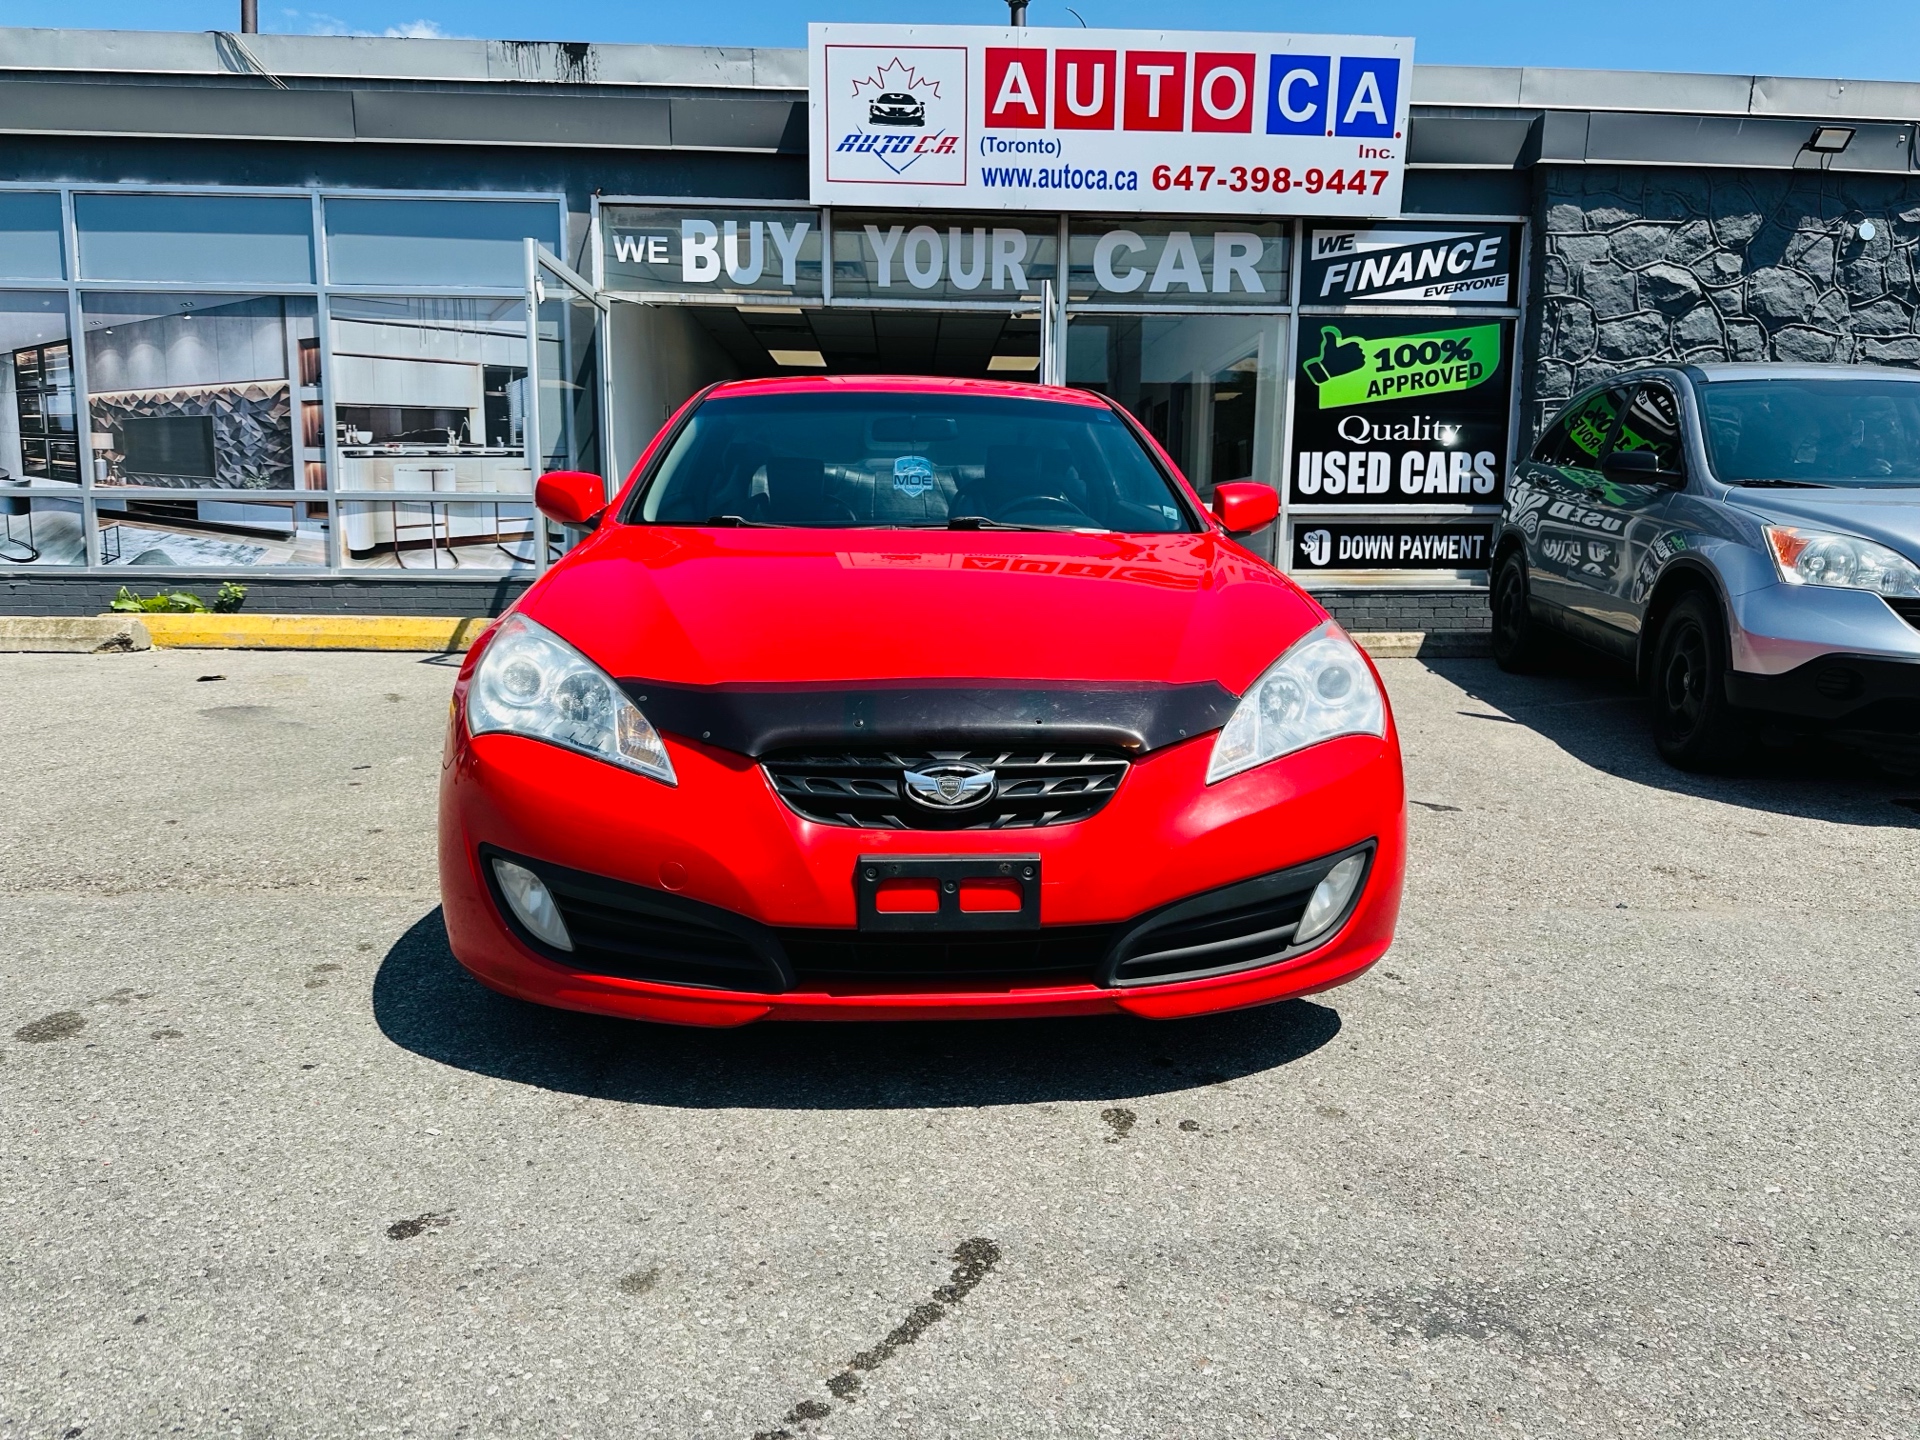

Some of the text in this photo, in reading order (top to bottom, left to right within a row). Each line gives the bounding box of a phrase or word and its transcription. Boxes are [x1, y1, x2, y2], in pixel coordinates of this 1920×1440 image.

[980, 136, 1062, 158] (Toronto)
[1358, 144, 1396, 160] Inc.
[982, 164, 1138, 191] www.autoca.ca
[1152, 164, 1390, 196] 647-398-9447
[613, 219, 1267, 294] WE BUY YOUR CAR
[1318, 233, 1355, 254] WE
[1319, 236, 1502, 298] FINANCE
[1423, 275, 1507, 298] EVERYONE
[1373, 337, 1474, 373] 100%
[1366, 361, 1483, 398] APPROVED
[1337, 415, 1463, 447] Quality
[894, 474, 932, 486] MOE
[1298, 450, 1392, 494] USED
[1400, 450, 1496, 494] CARS
[1339, 535, 1394, 560] DOWN
[1399, 535, 1485, 560] PAYMENT
